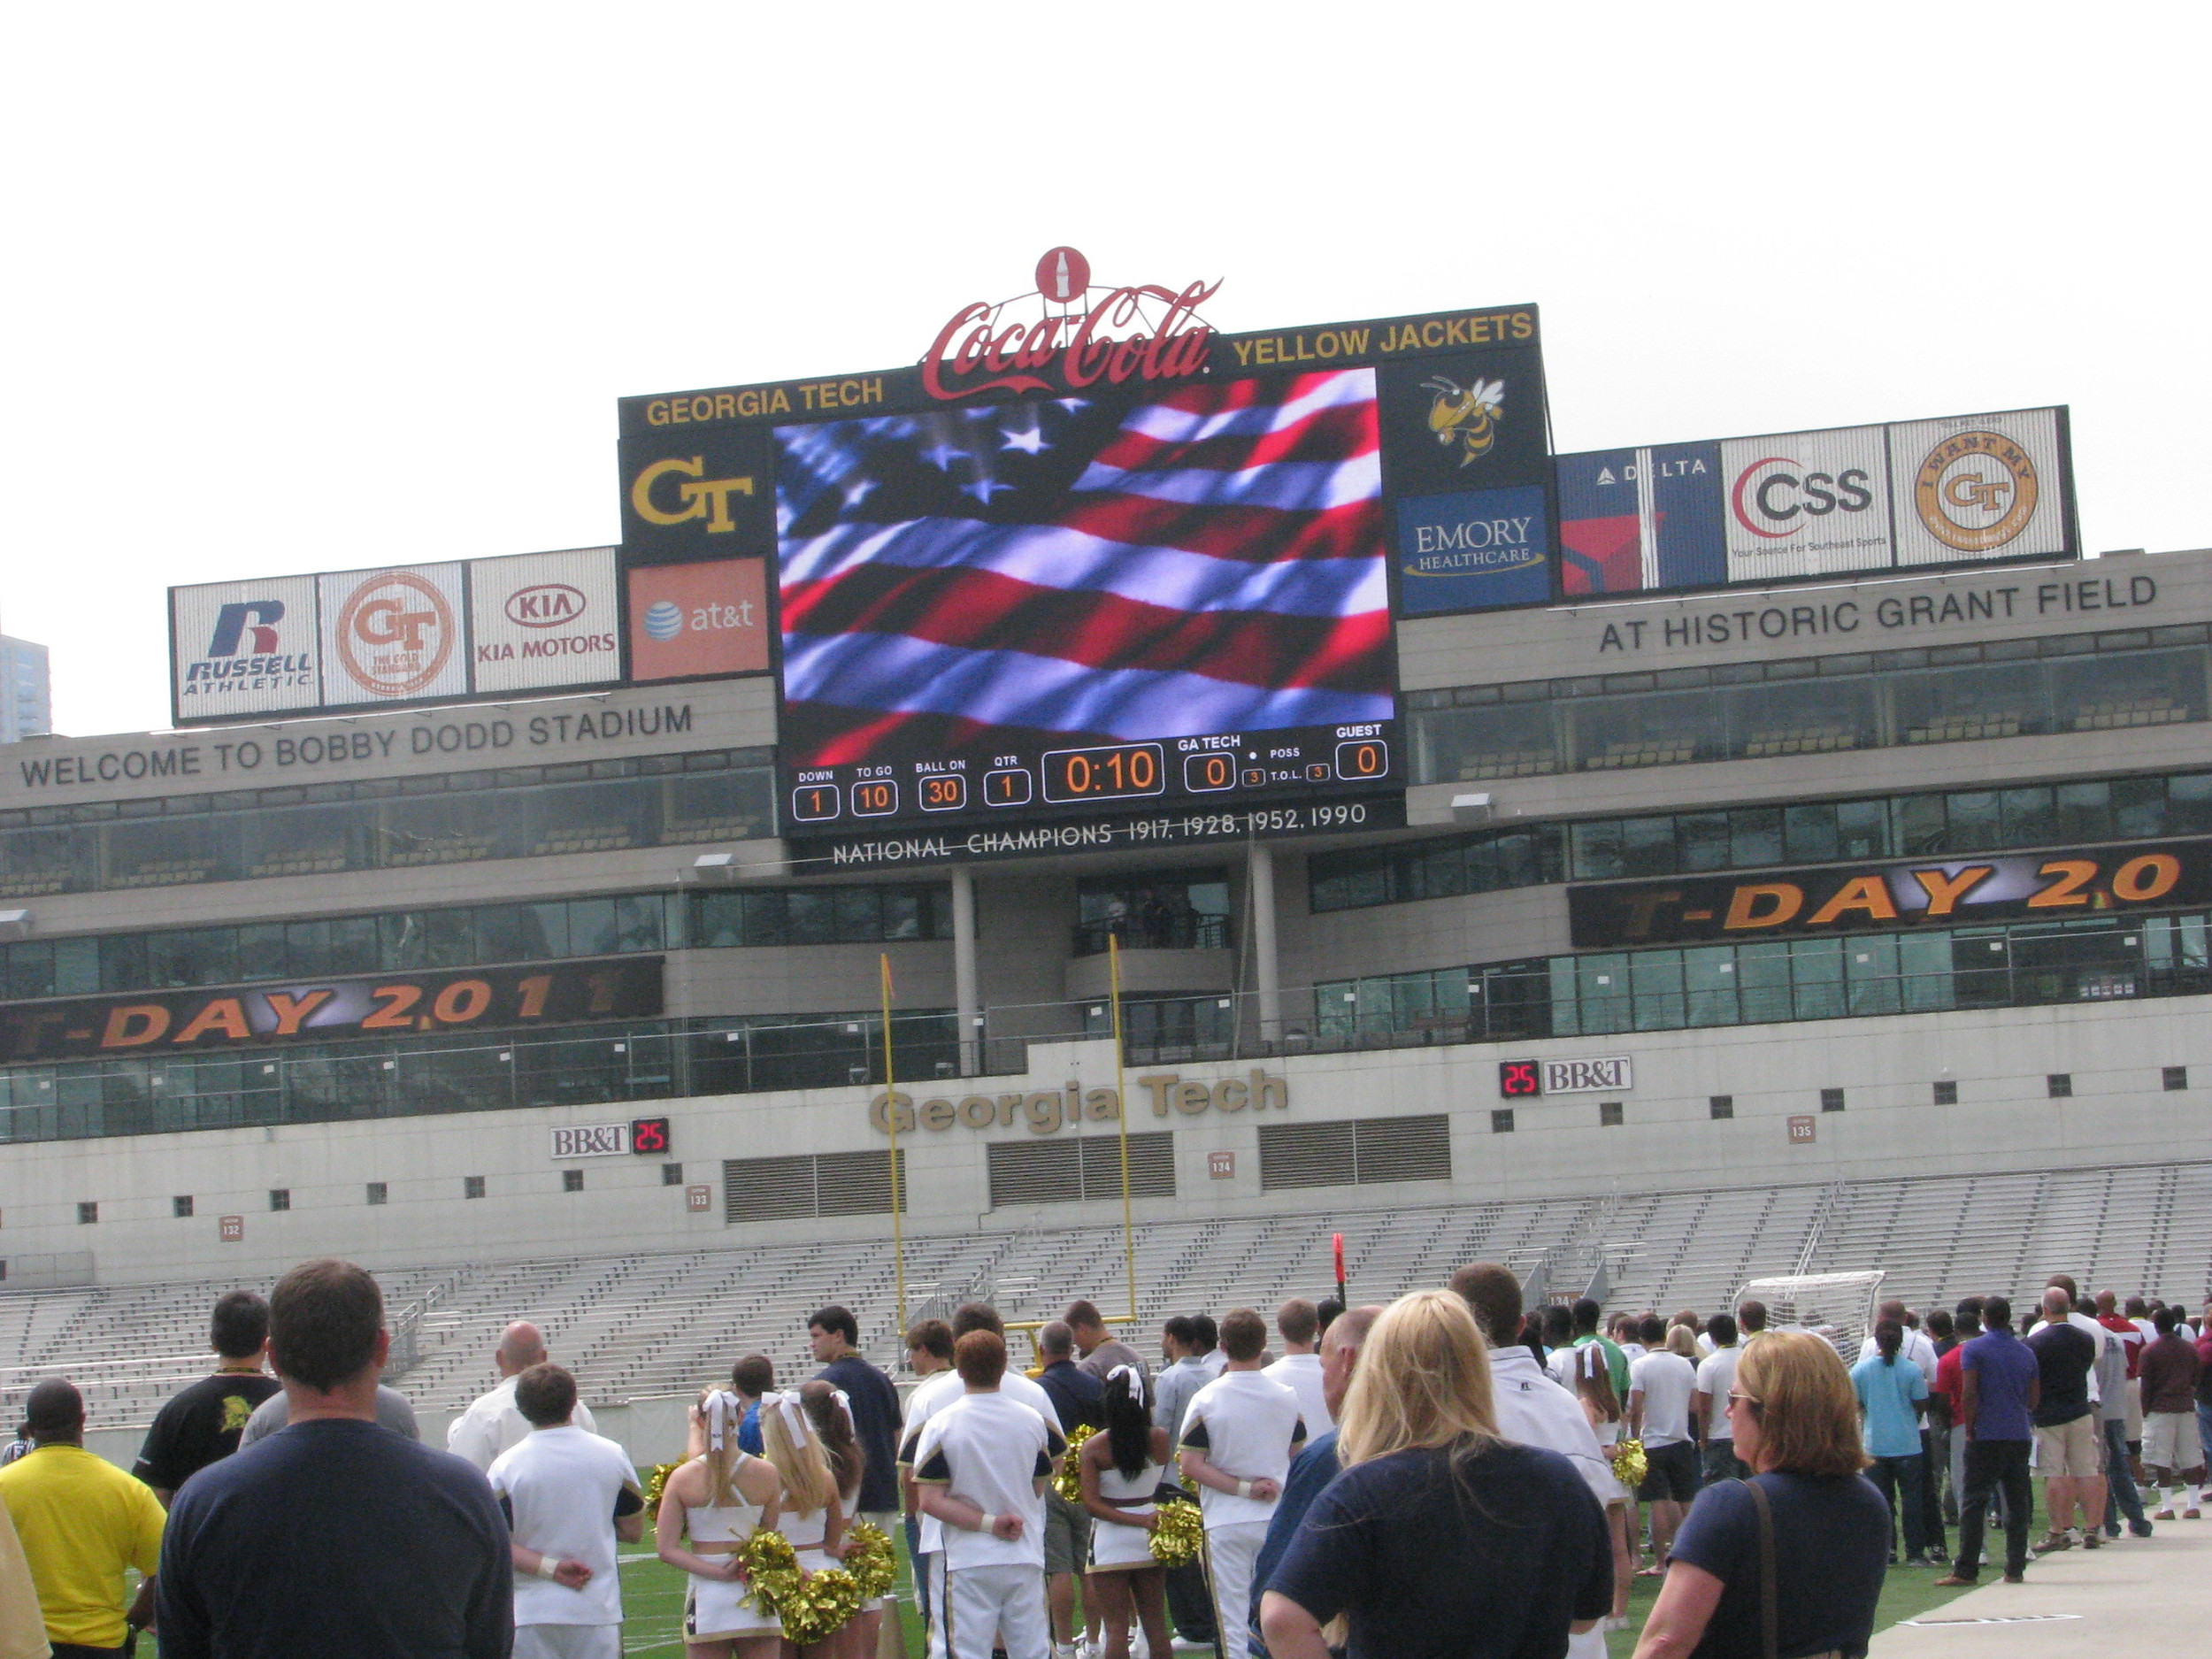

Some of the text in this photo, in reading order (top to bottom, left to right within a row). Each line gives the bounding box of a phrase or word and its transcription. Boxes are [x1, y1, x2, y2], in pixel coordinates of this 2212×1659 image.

[922, 276, 1225, 400] Coca-Cola
[1233, 311, 1533, 365] YELLOW JACKETS
[647, 377, 883, 426] GEORGIA TECH
[1624, 458, 1707, 482] DLTA
[1928, 437, 1997, 472] WANT
[2002, 448, 2031, 480] MY
[632, 456, 754, 534] GT
[1755, 468, 1873, 521] CSS
[1945, 472, 2010, 511] GT
[1417, 516, 1532, 553] EMORY
[1732, 548, 1753, 558] Your
[1790, 543, 1806, 553] For
[1808, 539, 1854, 551] Southeast
[1857, 536, 1886, 548] Sports
[1419, 548, 1531, 571] HEALTHCARE
[519, 593, 573, 619] KIA
[690, 599, 754, 631] at&t
[1600, 575, 2157, 653] AT HISTORIC GRANT FIELD
[356, 597, 436, 650] GT
[478, 633, 616, 664] KIA MOTORS
[186, 653, 312, 682] RUSSELL
[183, 674, 311, 696] ATHLETIC
[1178, 734, 1240, 751] GA TECH
[1336, 723, 1382, 739] GUEST
[20, 704, 692, 787] WELCOME TO BOBBY DODD STADIUM
[1270, 747, 1301, 759] POSS
[856, 765, 893, 779] TO GO
[915, 760, 966, 773] BALL ON
[994, 755, 1018, 767] QTR
[1066, 750, 1155, 794] 0:10
[1206, 757, 1226, 787] 0
[1313, 766, 1324, 779] 3
[1357, 746, 1378, 774] 0
[798, 770, 833, 783] DOWN
[1001, 775, 1013, 798] 1
[1249, 772, 1260, 784] 3
[1271, 771, 1302, 781] T.O.L.
[810, 790, 821, 813] 1
[860, 785, 889, 809] 10
[928, 780, 958, 803] 30
[833, 837, 952, 865] NATIONAL
[967, 824, 1112, 854] CHAMPIONS
[1311, 804, 1366, 826] 1990
[1504, 1064, 1537, 1094] 25
[1549, 1059, 1628, 1090] BB&T
[869, 1068, 1289, 1135] Georgia Tech
[553, 1125, 627, 1156] BB&T
[634, 1122, 665, 1150] 25
[1793, 1125, 1811, 1137] 135
[1213, 1161, 1230, 1172] 134
[691, 1194, 707, 1205] 133
[223, 1225, 239, 1235] 132
